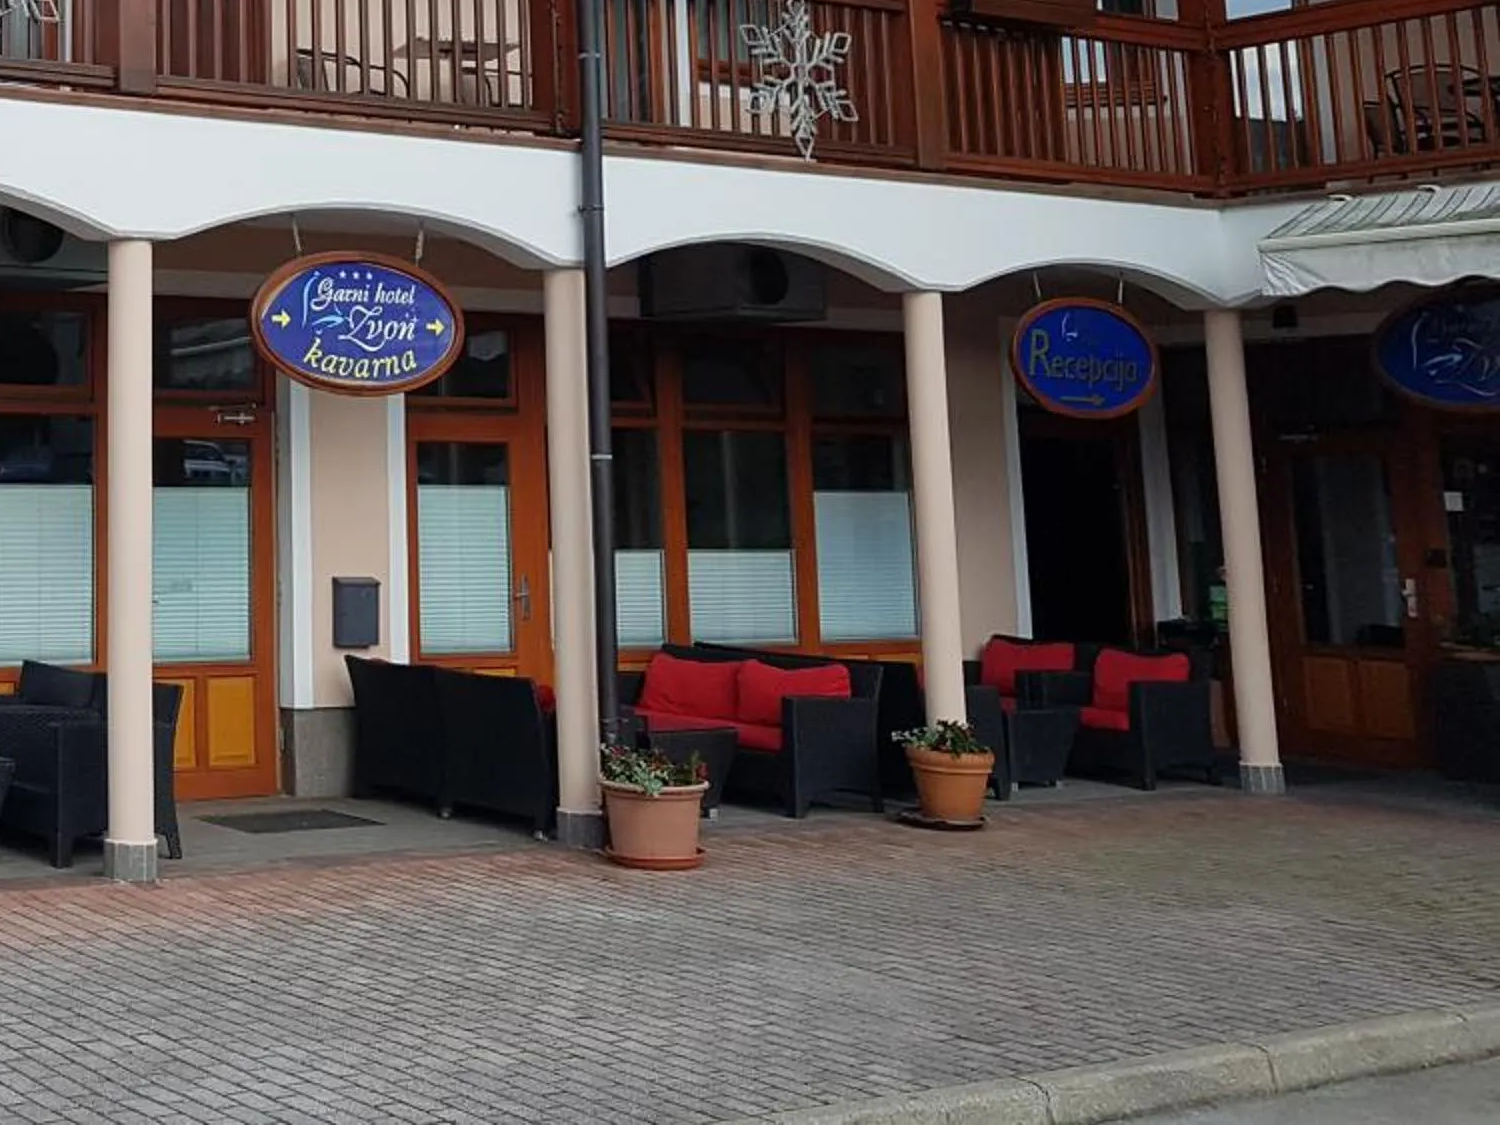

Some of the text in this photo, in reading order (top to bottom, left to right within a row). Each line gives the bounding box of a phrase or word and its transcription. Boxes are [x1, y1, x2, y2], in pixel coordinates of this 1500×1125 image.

[310, 276, 416, 311] Garni hotel
[338, 305, 416, 352] Zvon
[304, 339, 417, 378] kavarna
[1029, 328, 1137, 392] Recepcija
